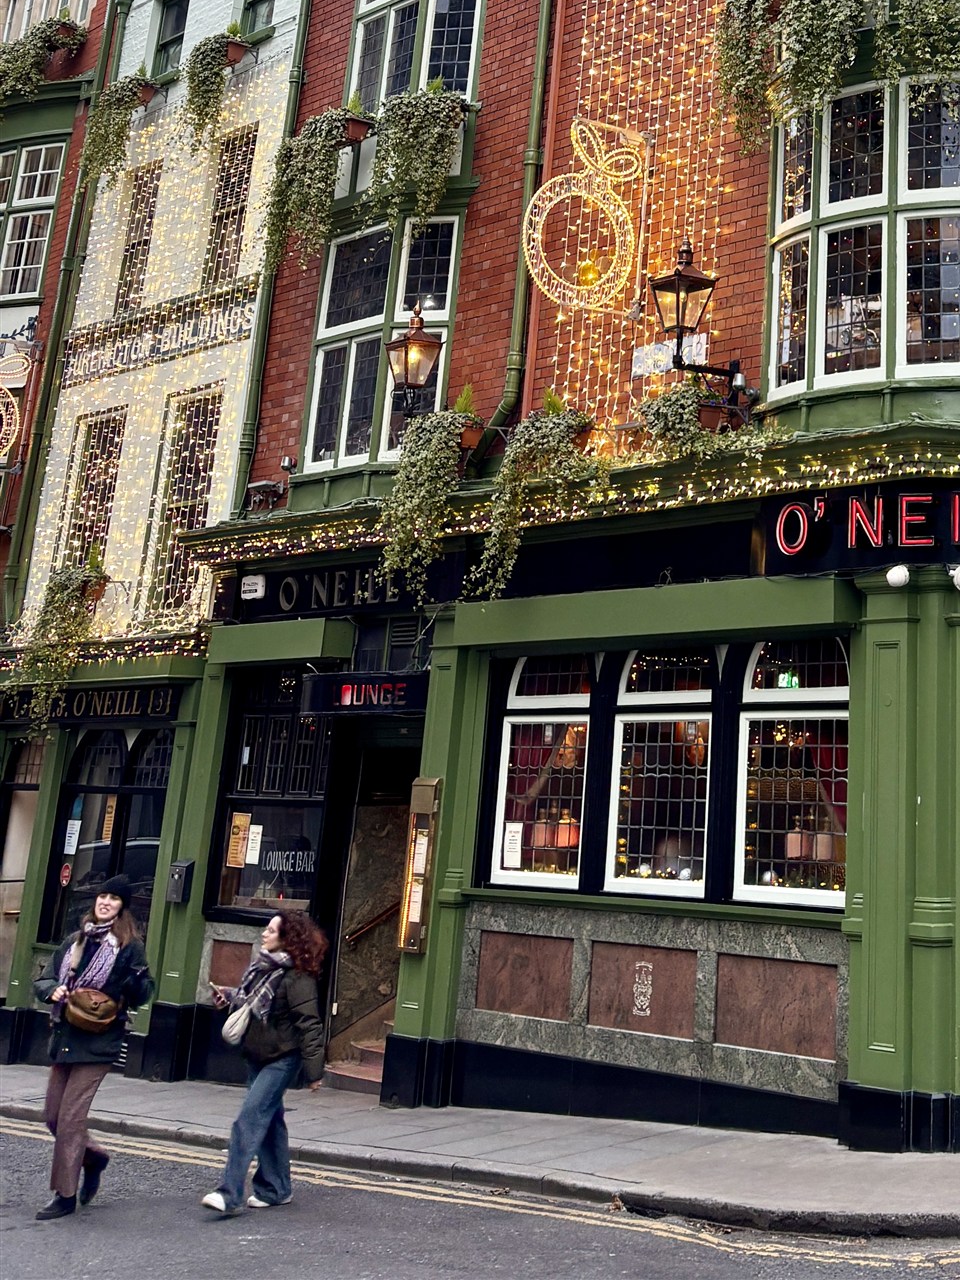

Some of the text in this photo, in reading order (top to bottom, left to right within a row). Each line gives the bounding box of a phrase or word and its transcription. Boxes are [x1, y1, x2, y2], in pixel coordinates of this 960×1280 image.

[160, 302, 256, 352] BUILDINGS
[73, 690, 142, 717] O'NEILL
[332, 683, 408, 706] LOUNGE
[261, 851, 315, 872] LOUNGE BAR
